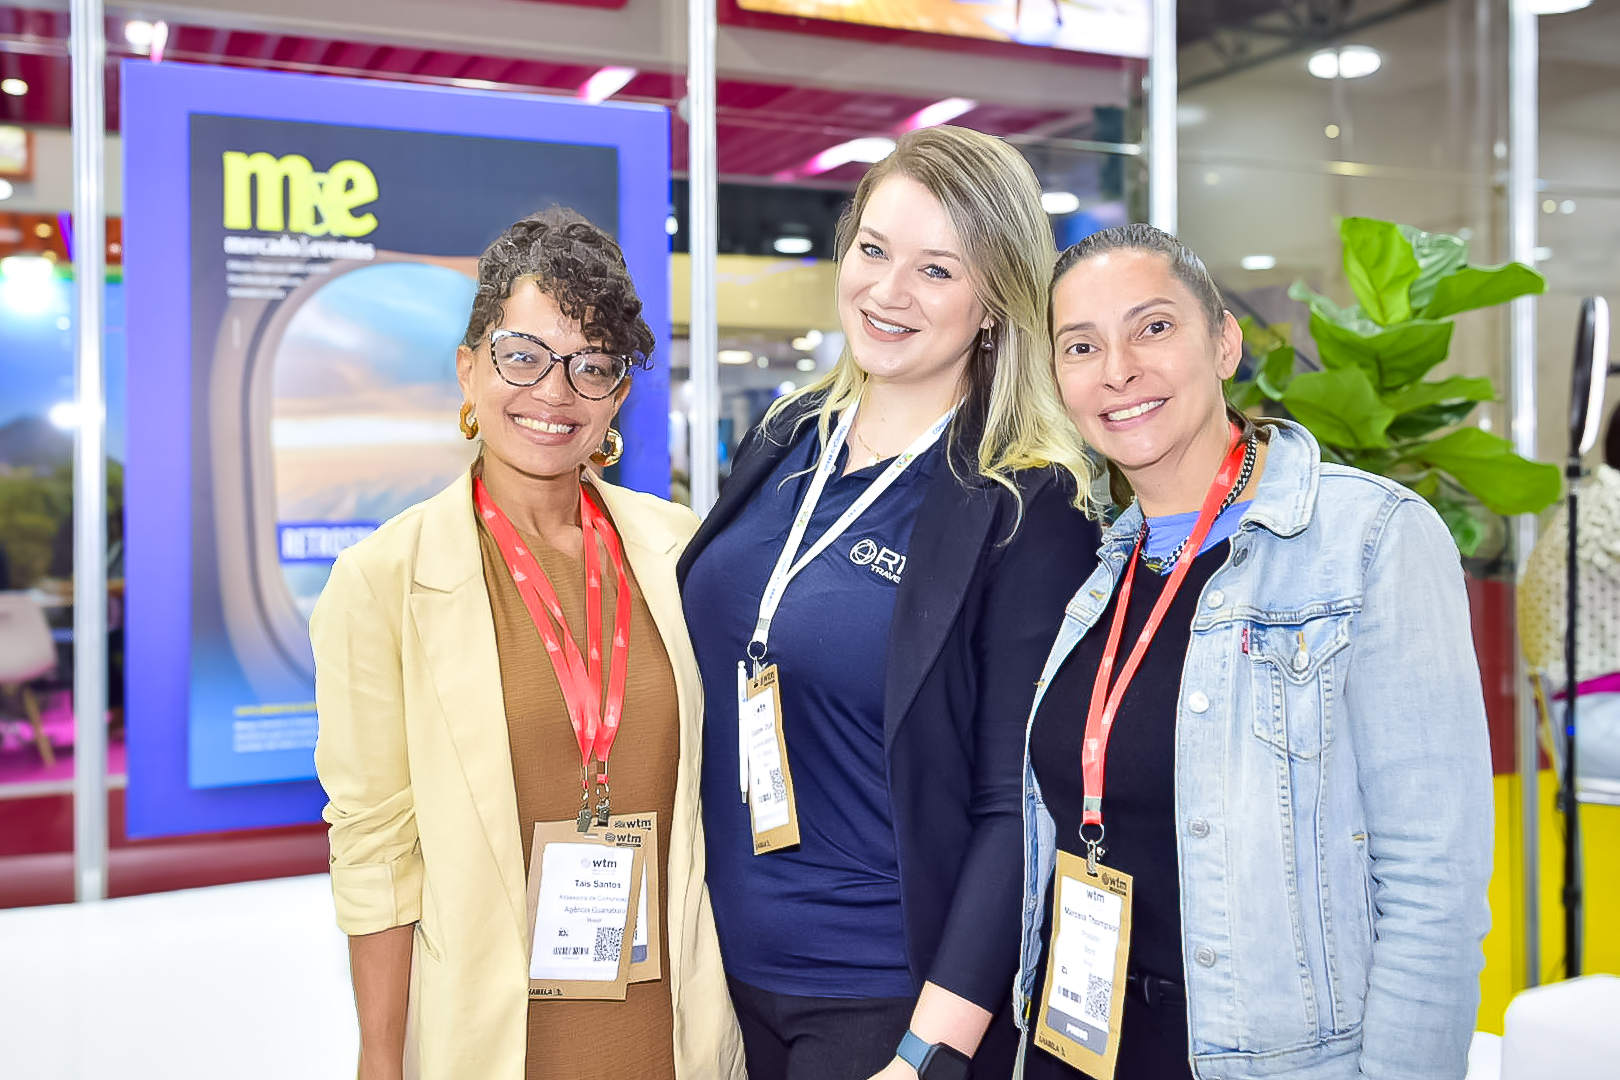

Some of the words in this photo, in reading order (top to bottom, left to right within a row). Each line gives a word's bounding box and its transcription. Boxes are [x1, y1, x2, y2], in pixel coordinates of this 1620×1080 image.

[626, 818, 652, 829] wtm
[616, 833, 641, 844] wtm
[592, 858, 618, 869] wtm
[593, 880, 622, 889] Santos
